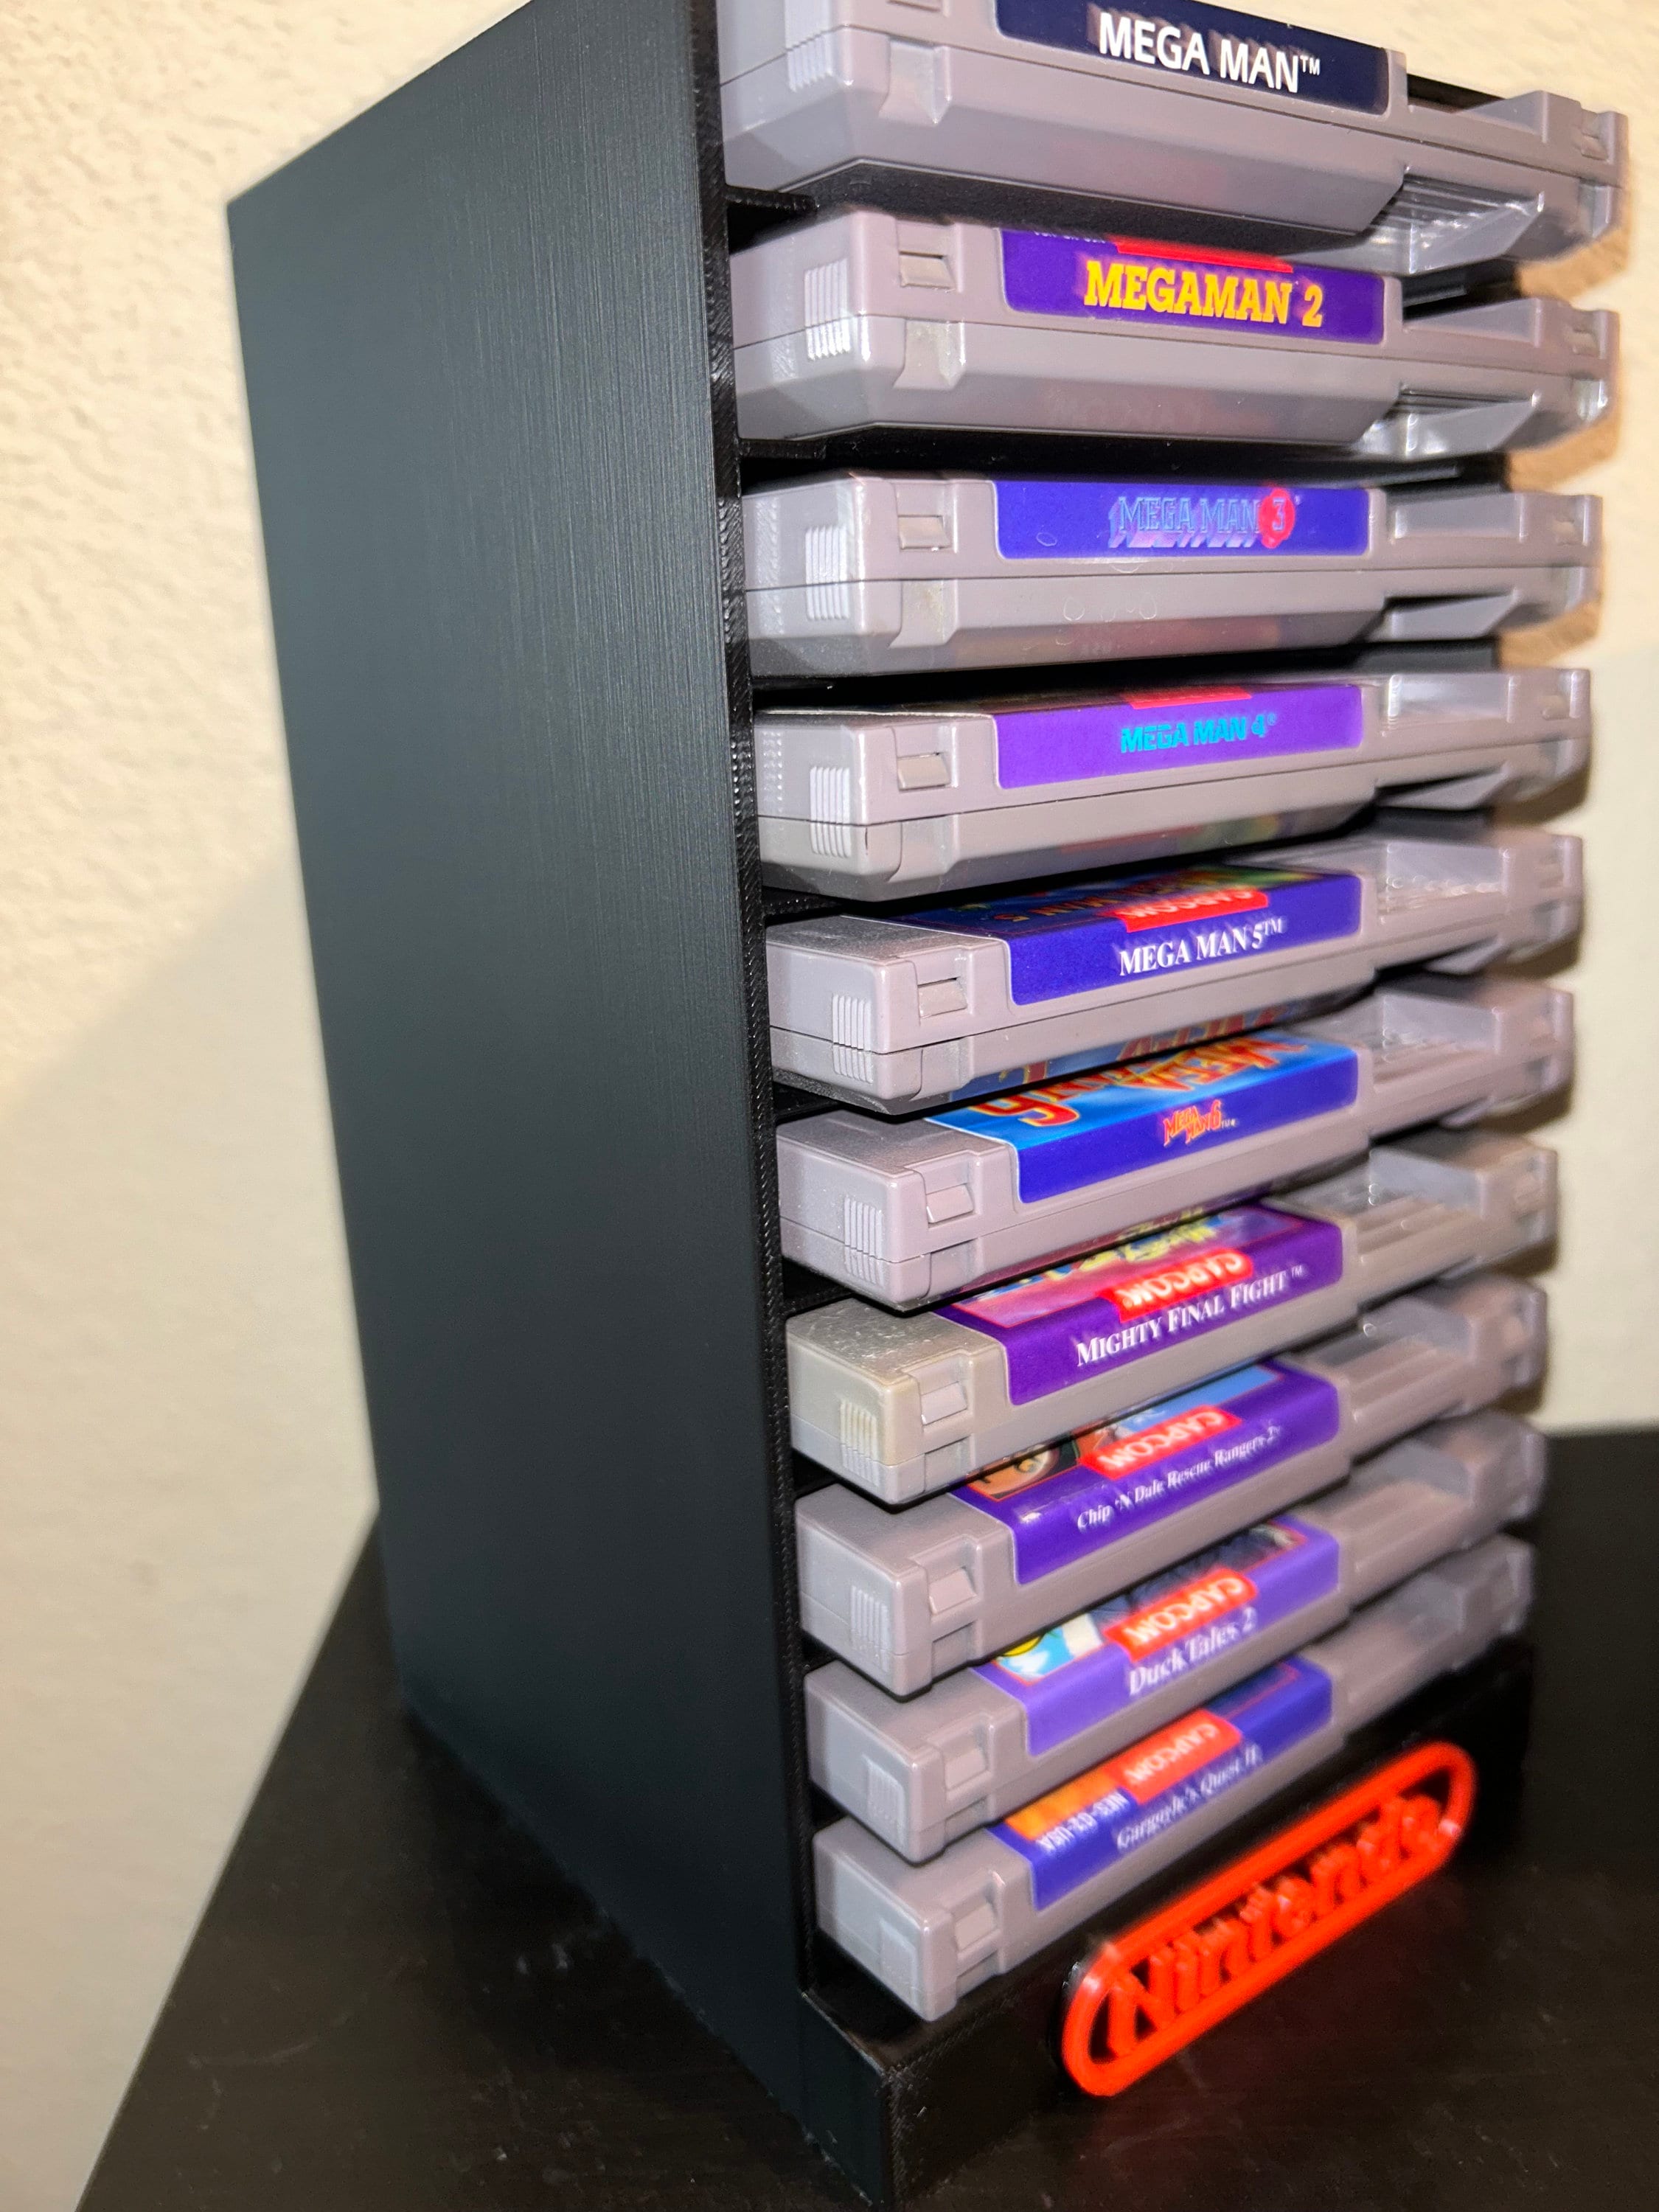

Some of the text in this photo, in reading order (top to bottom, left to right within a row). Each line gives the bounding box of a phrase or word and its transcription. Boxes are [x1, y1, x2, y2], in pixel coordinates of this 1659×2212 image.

[1099, 12, 1210, 75] MEGA
[1301, 285, 1324, 328] 2
[1115, 496, 1286, 537] MEGA MAN 3
[1120, 722, 1190, 754] MEGA
[1193, 715, 1248, 745] MAN
[1119, 941, 1192, 976] MEGA
[1195, 926, 1248, 961] MAN
[1076, 1317, 1164, 1368] MIGHTY
[1167, 1295, 1226, 1335] FINAL
[1230, 1270, 1288, 1309] FIGHT
[1096, 1410, 1227, 1471] CAPCOM
[1077, 1503, 1113, 1530] Chip
[1133, 1478, 1165, 1504] Dale
[1167, 1459, 1211, 1489] Rescue
[1213, 1436, 1267, 1467] Rangers
[1124, 1572, 1245, 1646] CAPCOM
[1129, 1607, 1257, 1696] Duck Tales 2
